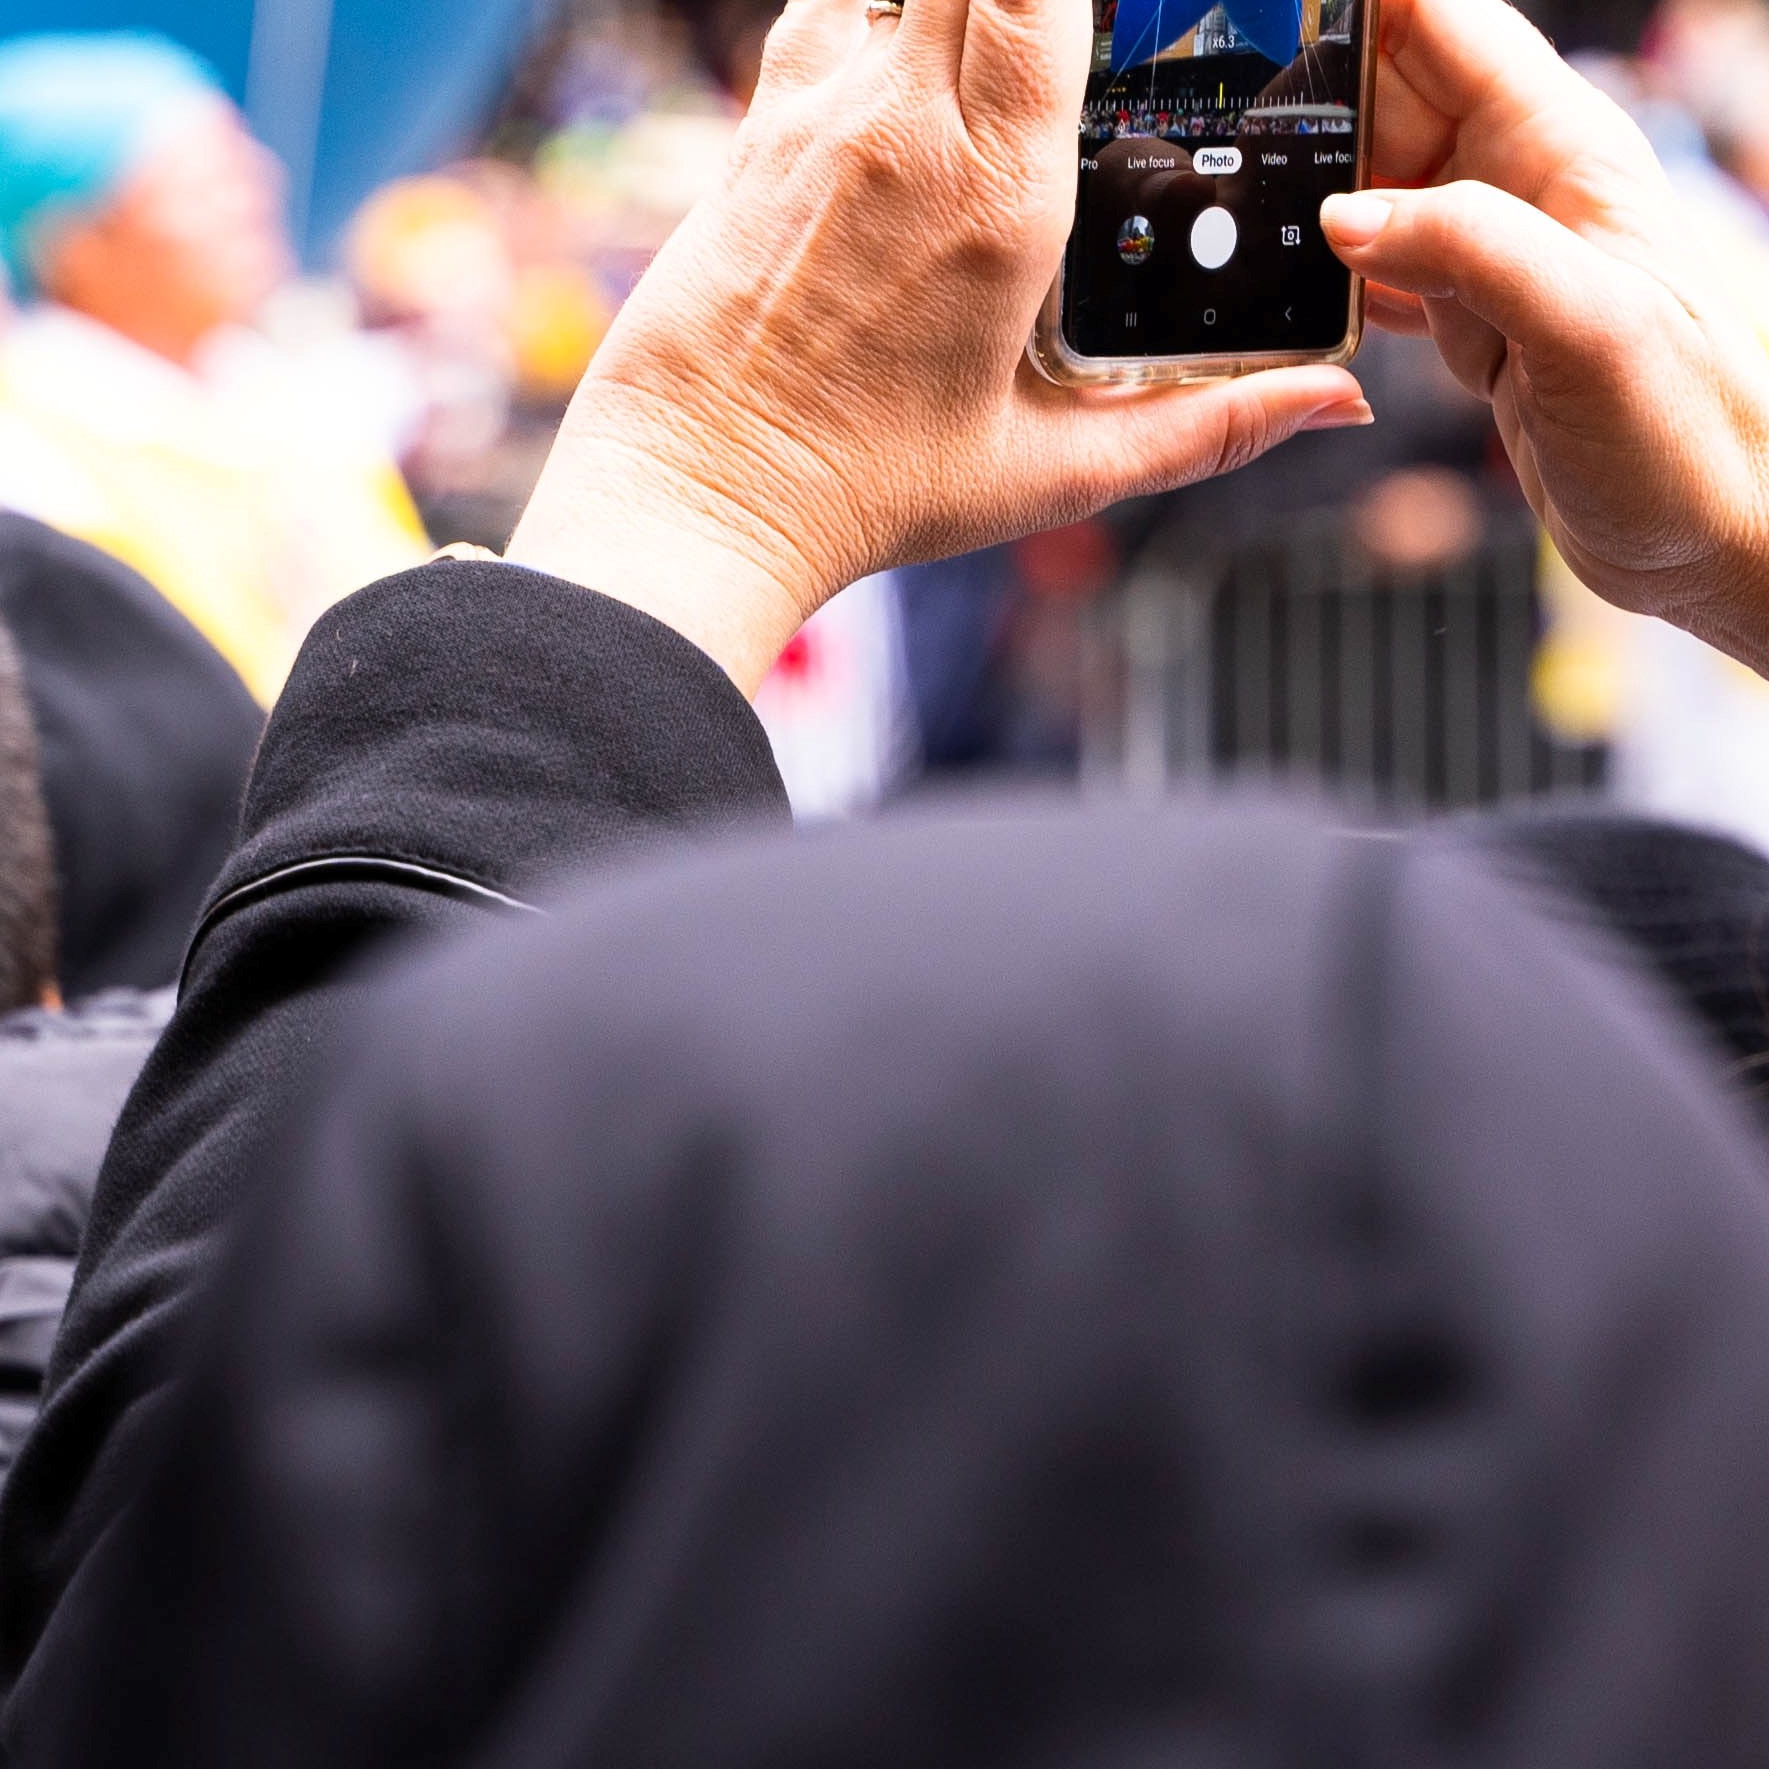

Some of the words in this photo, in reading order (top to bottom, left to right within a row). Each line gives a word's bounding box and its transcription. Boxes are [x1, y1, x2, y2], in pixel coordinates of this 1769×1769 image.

[1213, 35, 1235, 49] x6.3
[1080, 158, 1099, 170] Pro
[1127, 157, 1147, 169] Live
[1149, 156, 1175, 169] focus
[1202, 154, 1234, 167] Photo
[1261, 153, 1288, 165] Video
[1314, 152, 1333, 164] Live
